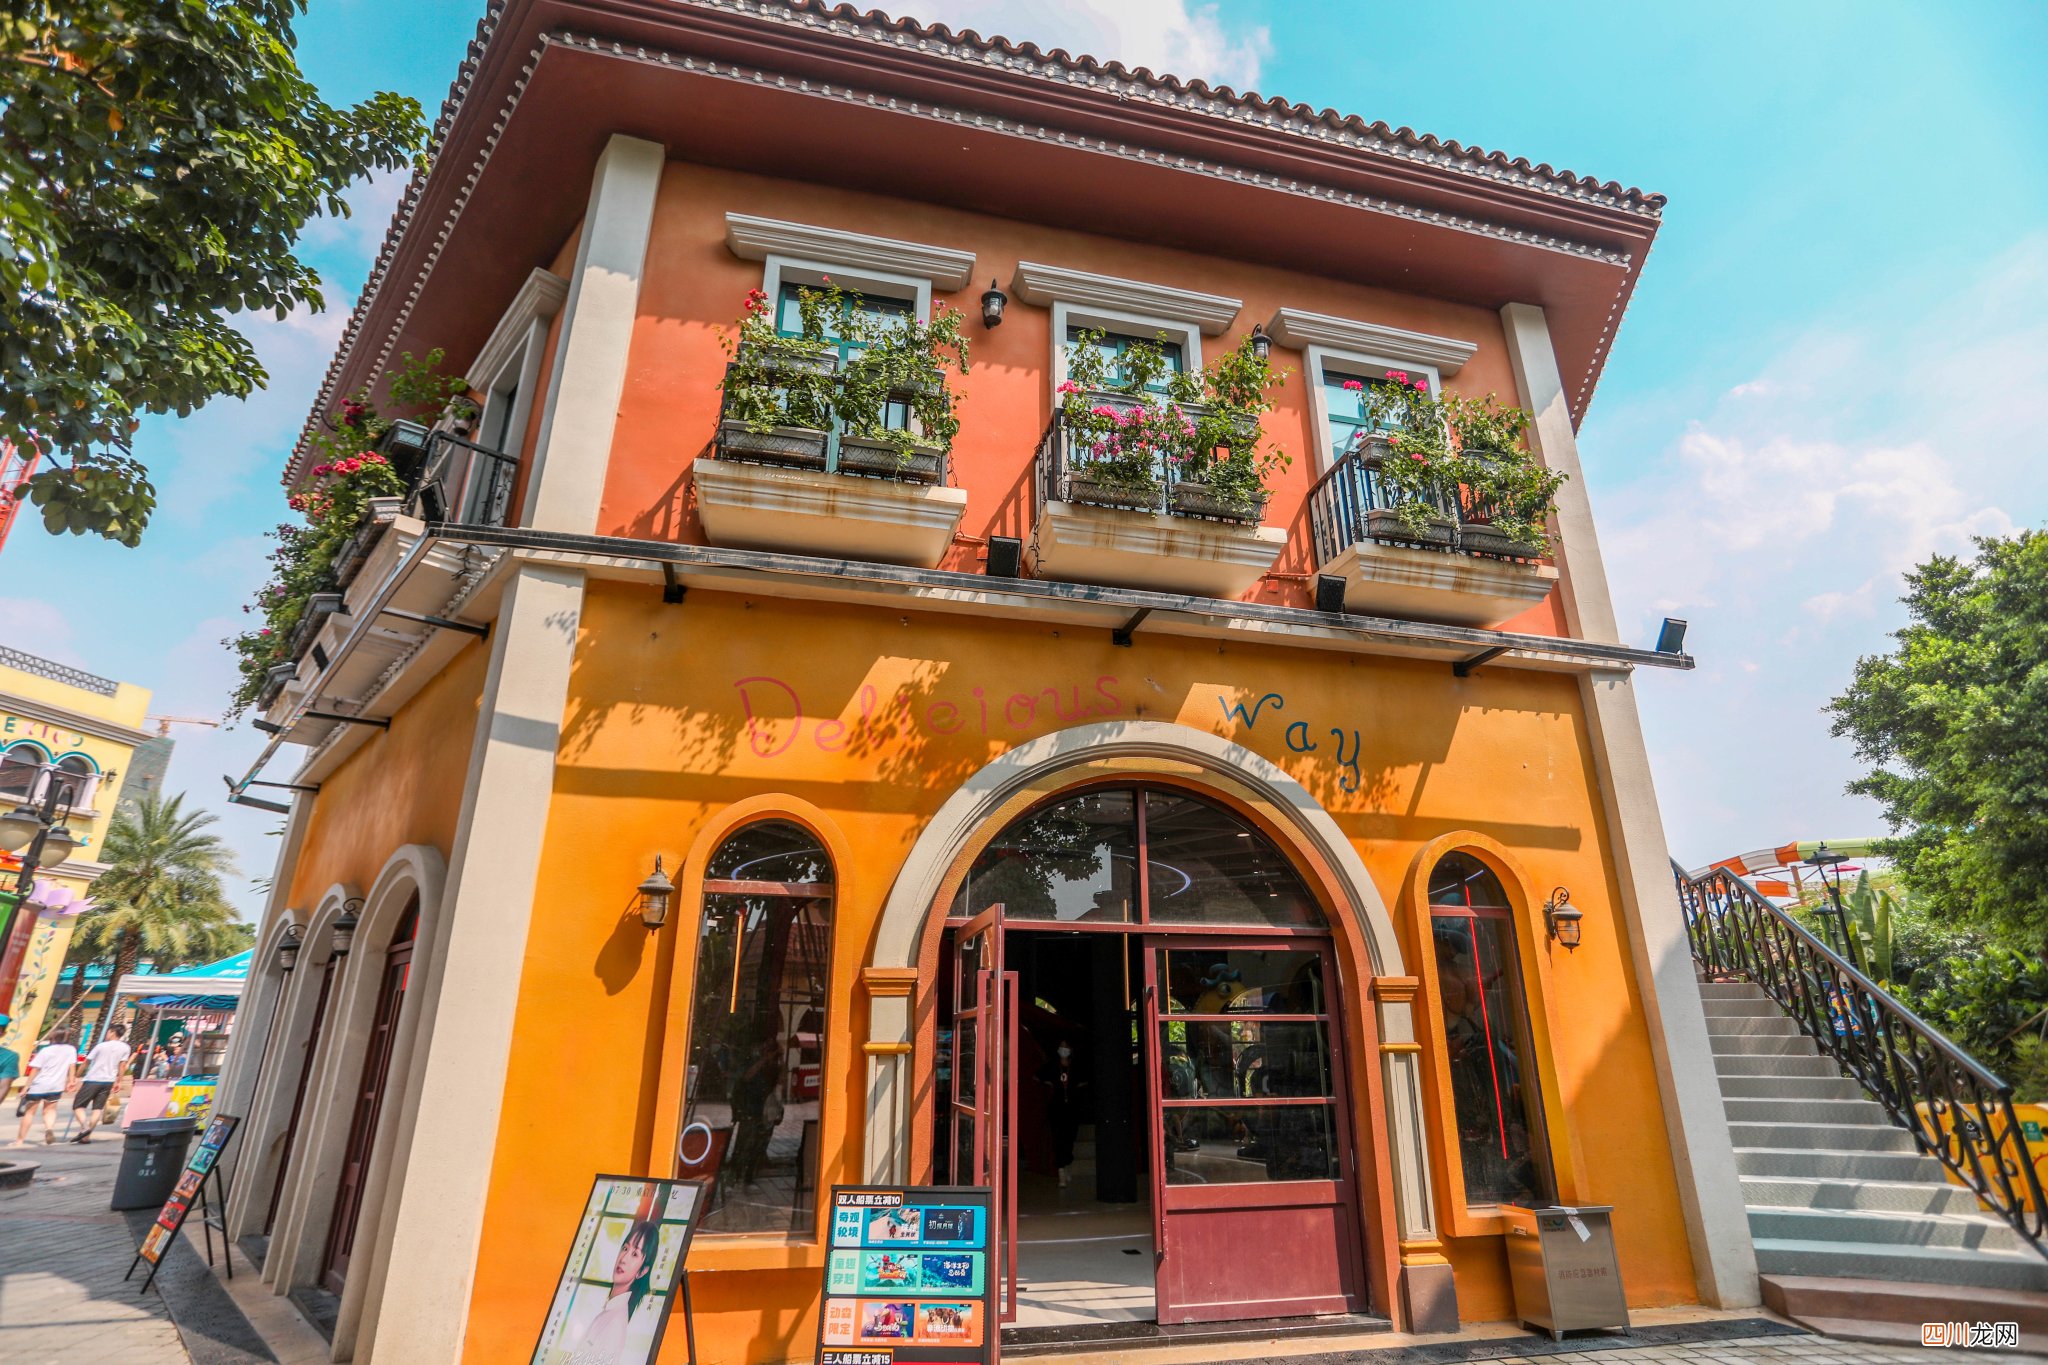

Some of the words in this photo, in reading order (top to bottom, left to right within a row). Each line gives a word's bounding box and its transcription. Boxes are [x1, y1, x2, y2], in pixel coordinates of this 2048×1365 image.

[734, 675, 1125, 758] Delicious
[837, 1194, 901, 1206] 双人船票立减10
[839, 1212, 860, 1224] 奇观
[837, 1226, 859, 1239] 秘境
[828, 1322, 851, 1336] 限定
[822, 1353, 891, 1365] 三人船票立减15
